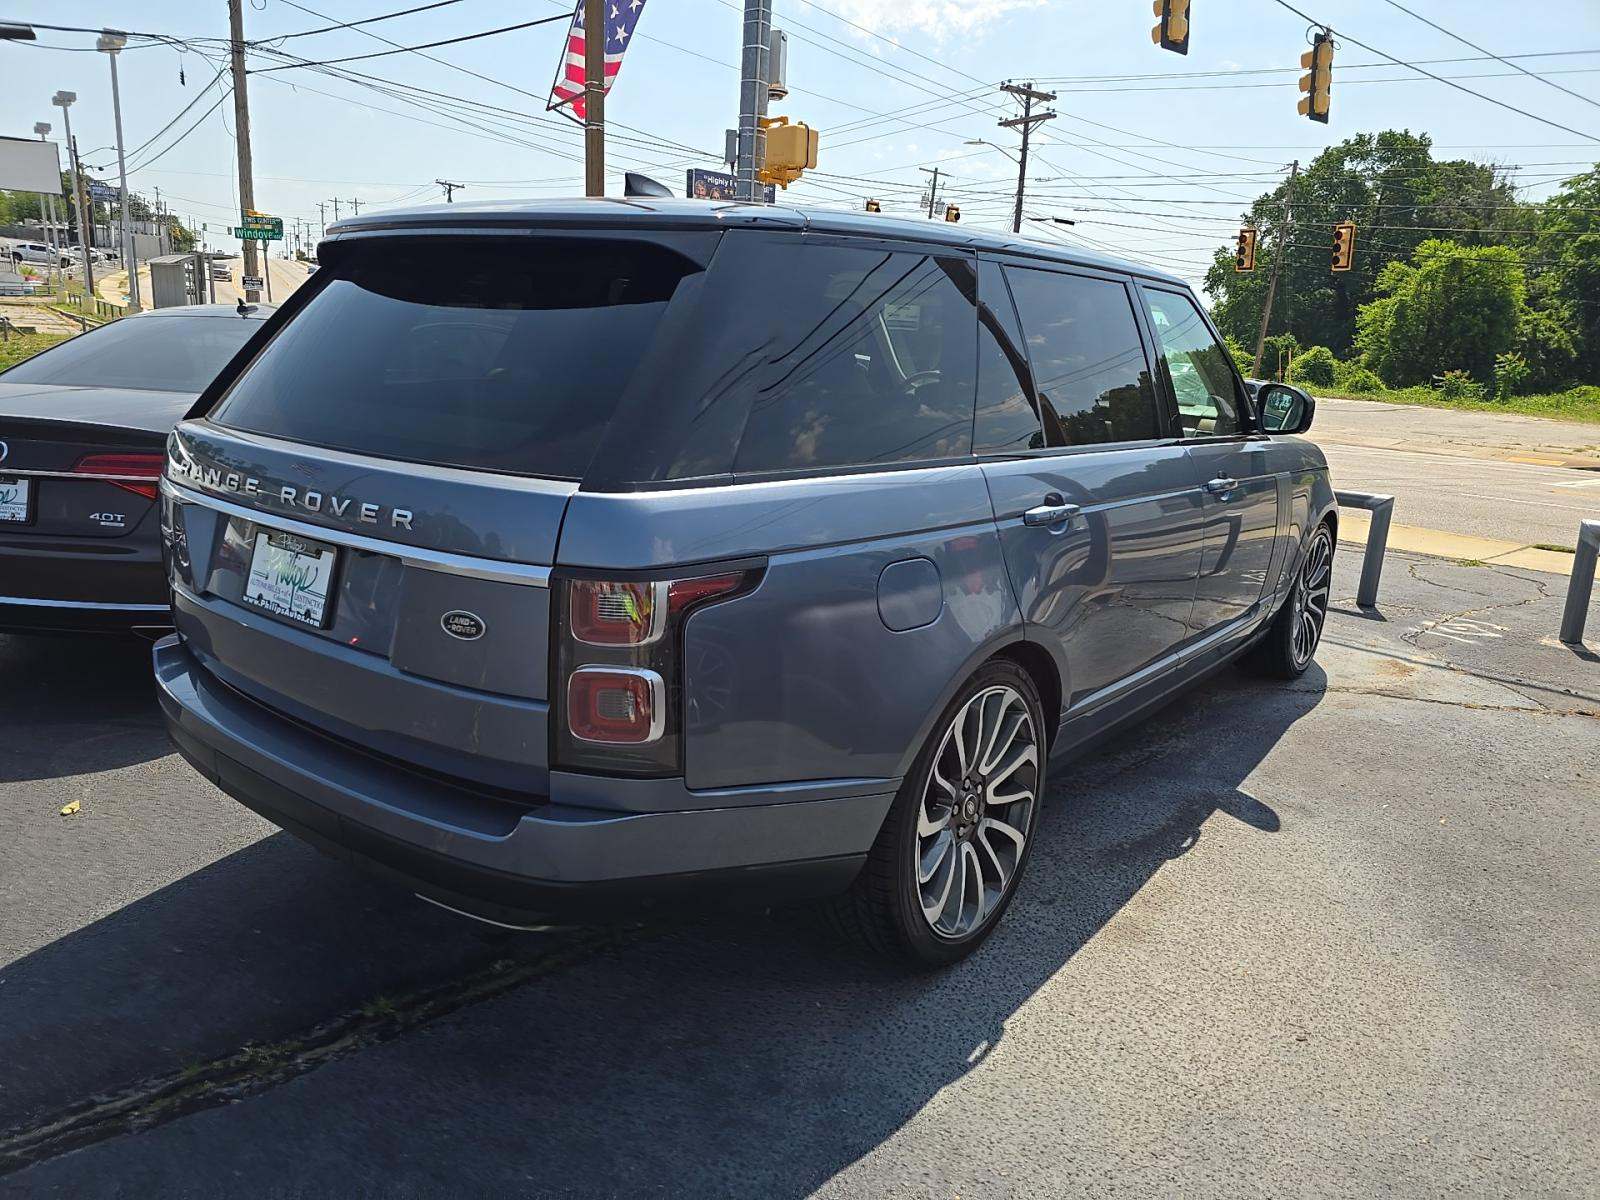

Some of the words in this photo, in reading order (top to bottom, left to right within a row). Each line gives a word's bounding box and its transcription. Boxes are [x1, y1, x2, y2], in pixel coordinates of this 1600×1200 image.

[180, 460, 260, 496] RANGE
[280, 486, 413, 530] ROVER
[242, 595, 320, 627] www.PhilipsAutos.com
[449, 615, 470, 625] LAND
[451, 623, 477, 635] ROVER
